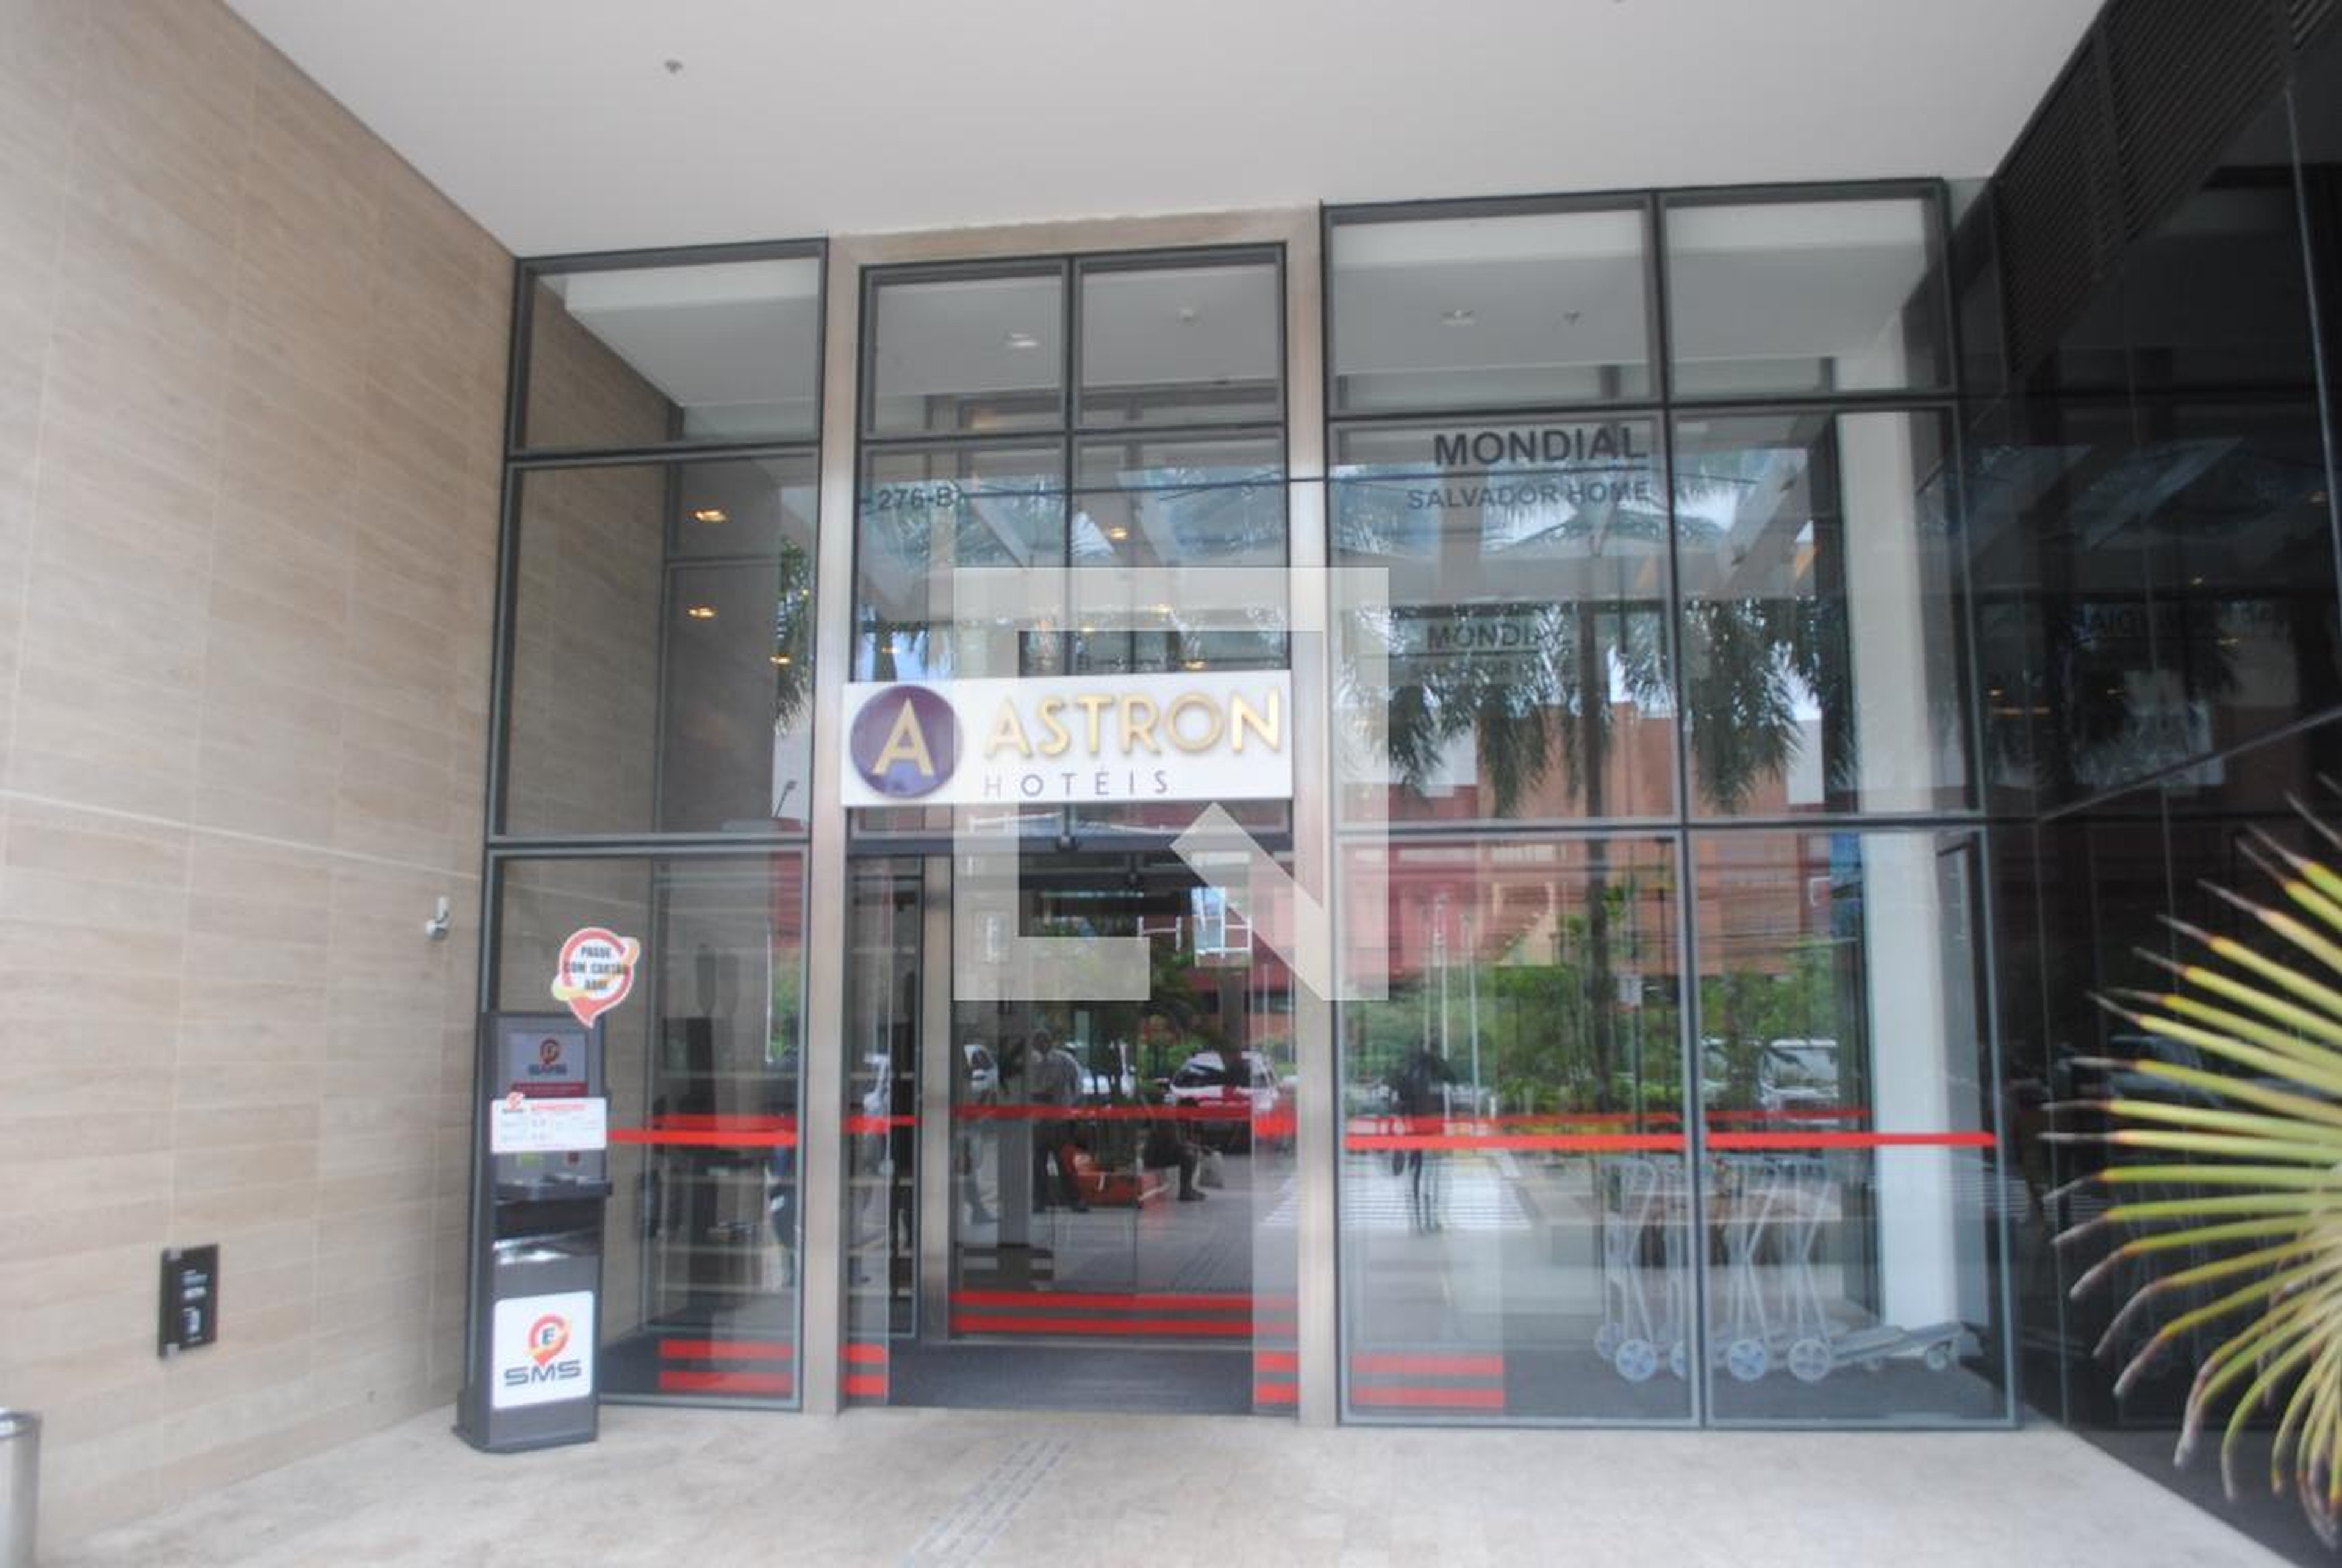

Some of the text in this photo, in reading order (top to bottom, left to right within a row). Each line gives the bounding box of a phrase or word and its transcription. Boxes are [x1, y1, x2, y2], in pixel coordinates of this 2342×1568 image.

[1434, 427, 1648, 465] MONDIAL
[877, 486, 954, 511] 276-B
[1409, 482, 1649, 509] SALVADOR HOME
[1428, 622, 1572, 650] MONDI
[872, 696, 936, 776] A
[983, 686, 1281, 759] ASTRON
[504, 1359, 582, 1387] SMS
